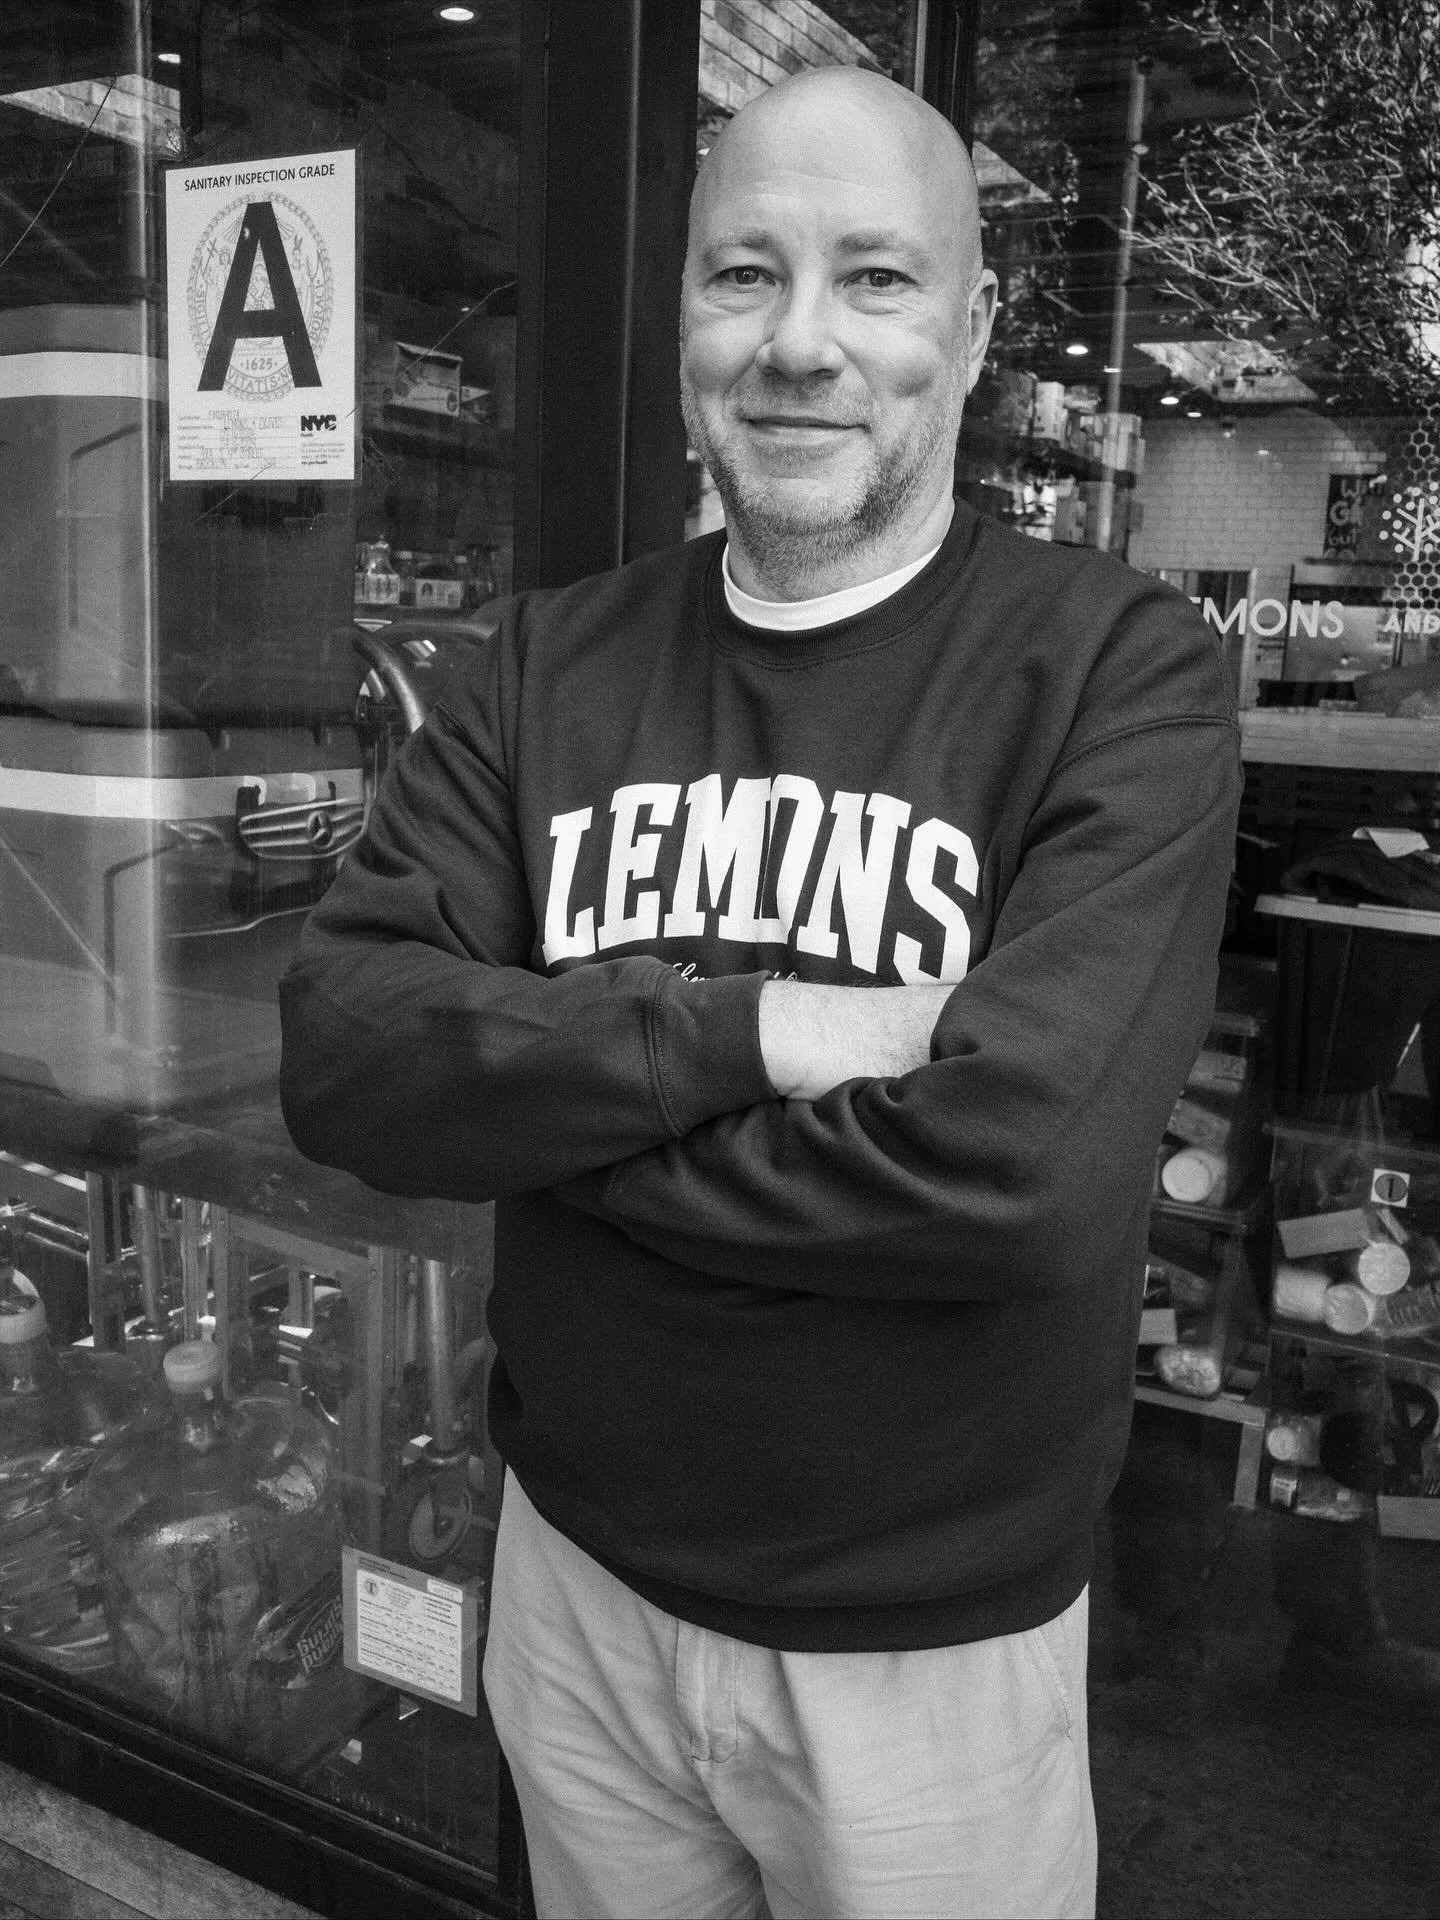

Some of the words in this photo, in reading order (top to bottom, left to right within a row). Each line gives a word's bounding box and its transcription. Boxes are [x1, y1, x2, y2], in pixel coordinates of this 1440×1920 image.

[184, 175, 232, 191] SANITARY
[234, 167, 296, 186] INSPECTION
[298, 163, 335, 179] GRADE
[197, 201, 322, 392] A
[246, 358, 273, 371] 1625
[300, 415, 337, 432] NYC
[1189, 597, 1345, 639] MONS
[1383, 610, 1440, 634] AND
[542, 774, 979, 986] LEMONS
